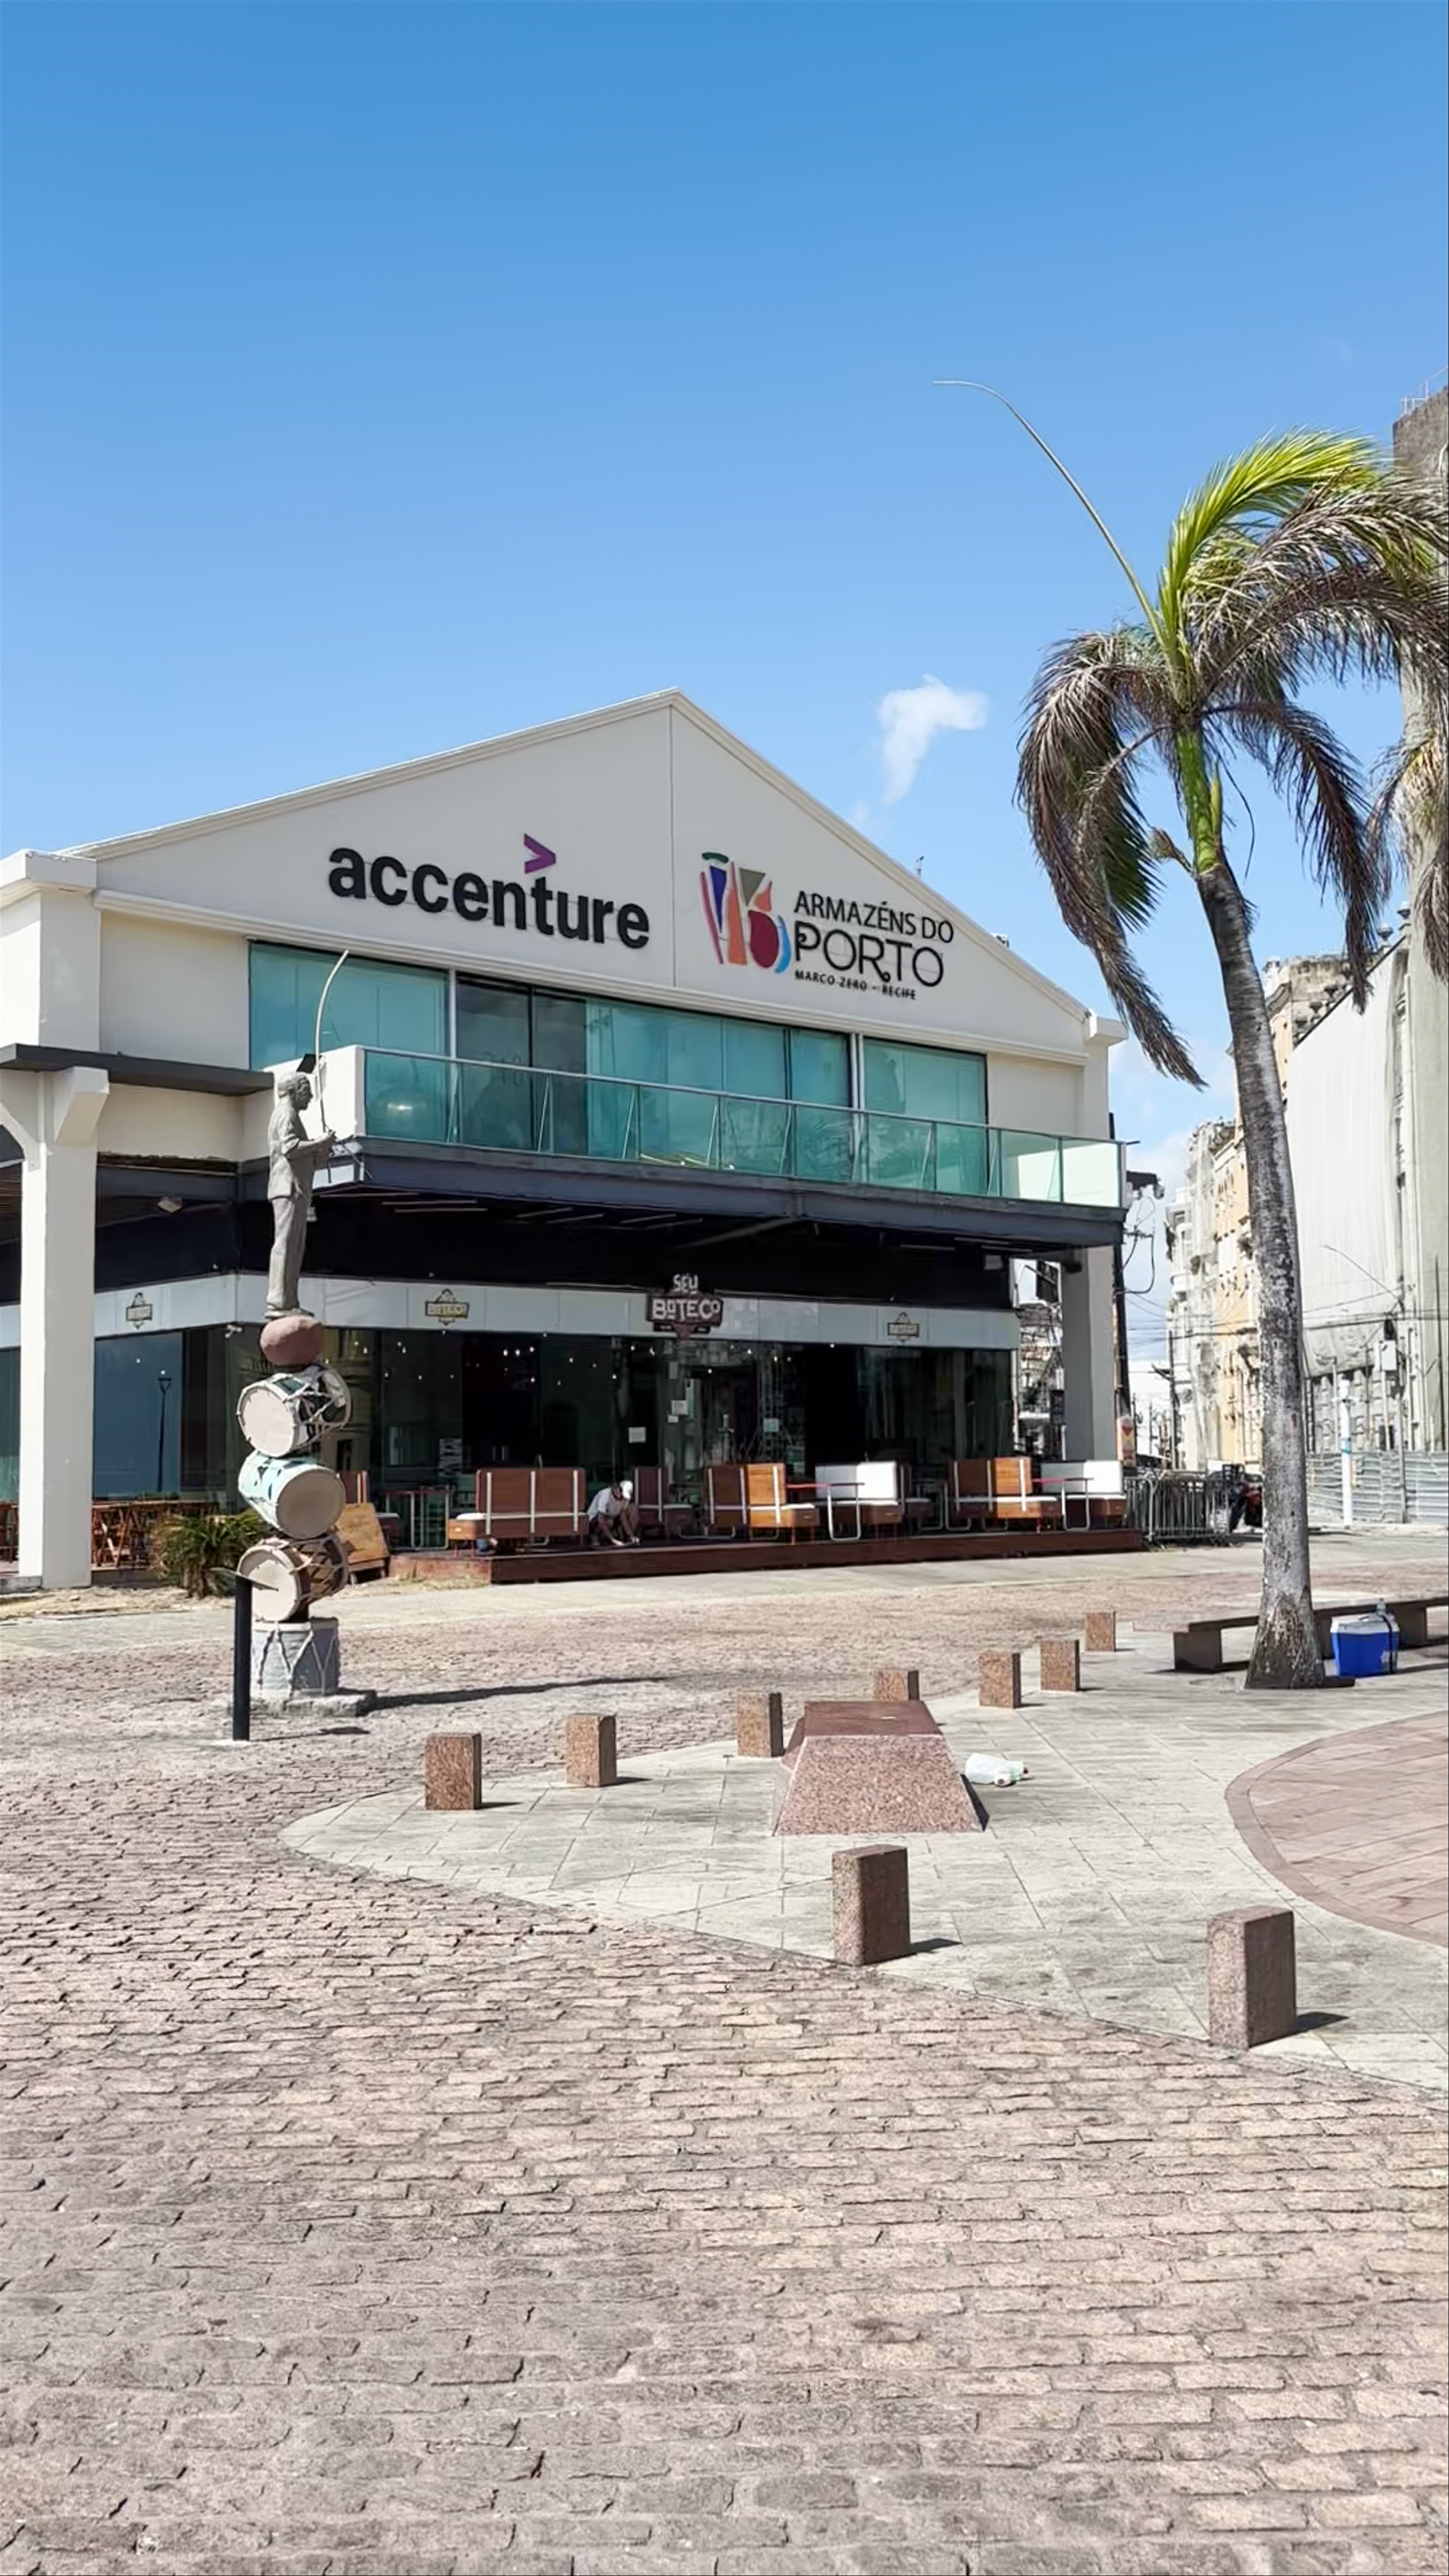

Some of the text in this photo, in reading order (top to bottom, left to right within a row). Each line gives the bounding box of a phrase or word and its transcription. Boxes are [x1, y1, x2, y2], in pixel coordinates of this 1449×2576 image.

[328, 847, 650, 949] accenture
[794, 890, 954, 943] ARMAZÉNS DO
[794, 920, 943, 987] PORTO
[795, 970, 835, 985] MARCO
[839, 977, 867, 991] ZERO
[882, 984, 916, 1000] RECIFE
[674, 1274, 698, 1294] SEU
[652, 1299, 720, 1321] BOTECO
